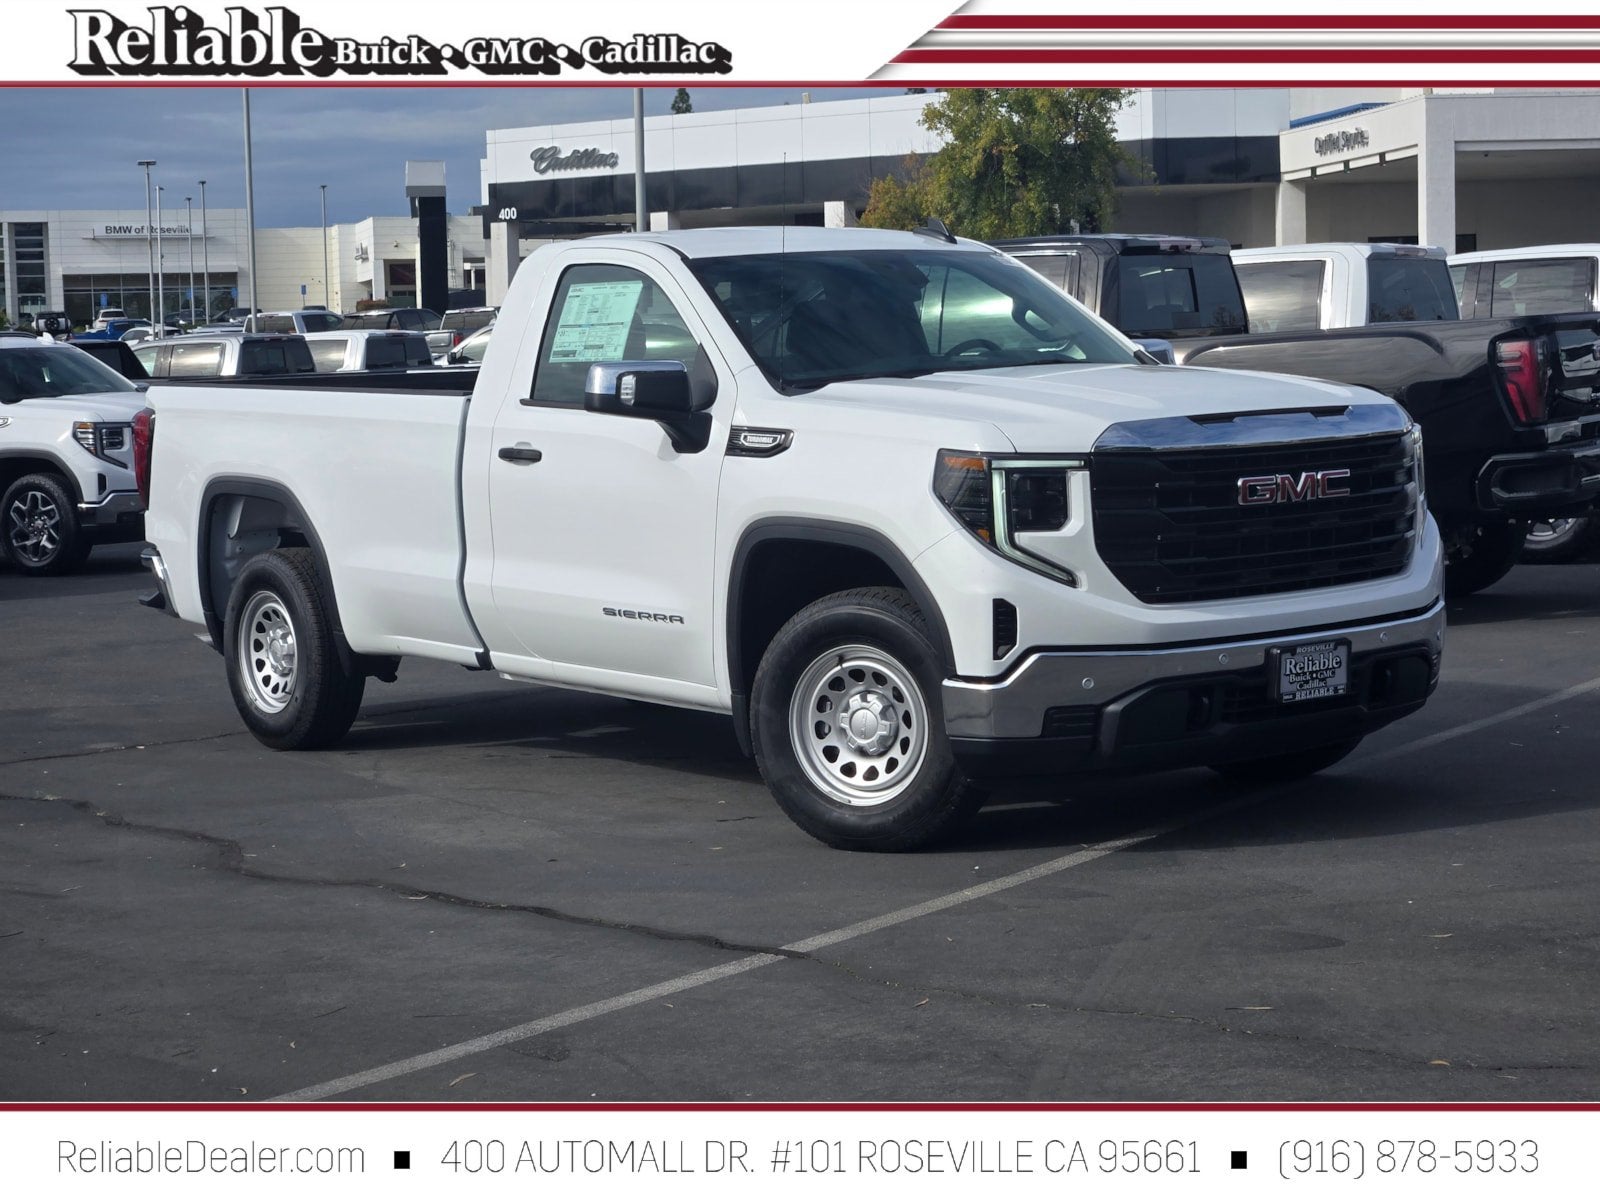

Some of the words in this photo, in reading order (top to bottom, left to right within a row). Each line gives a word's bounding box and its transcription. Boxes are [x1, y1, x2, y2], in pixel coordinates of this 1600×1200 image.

[530, 145, 619, 175] Cadillac
[498, 206, 517, 220] 400
[105, 225, 132, 234] BMW
[134, 225, 144, 234] of
[1237, 468, 1351, 505] GMC
[602, 607, 685, 624] SIERRA
[1296, 643, 1334, 653] ROSEVILLE
[1285, 652, 1341, 674] Reliable
[1289, 673, 1311, 683] Buick
[1317, 670, 1336, 679] GMC
[1296, 680, 1327, 690] Cadillac
[1295, 687, 1334, 700] RELIABLE
